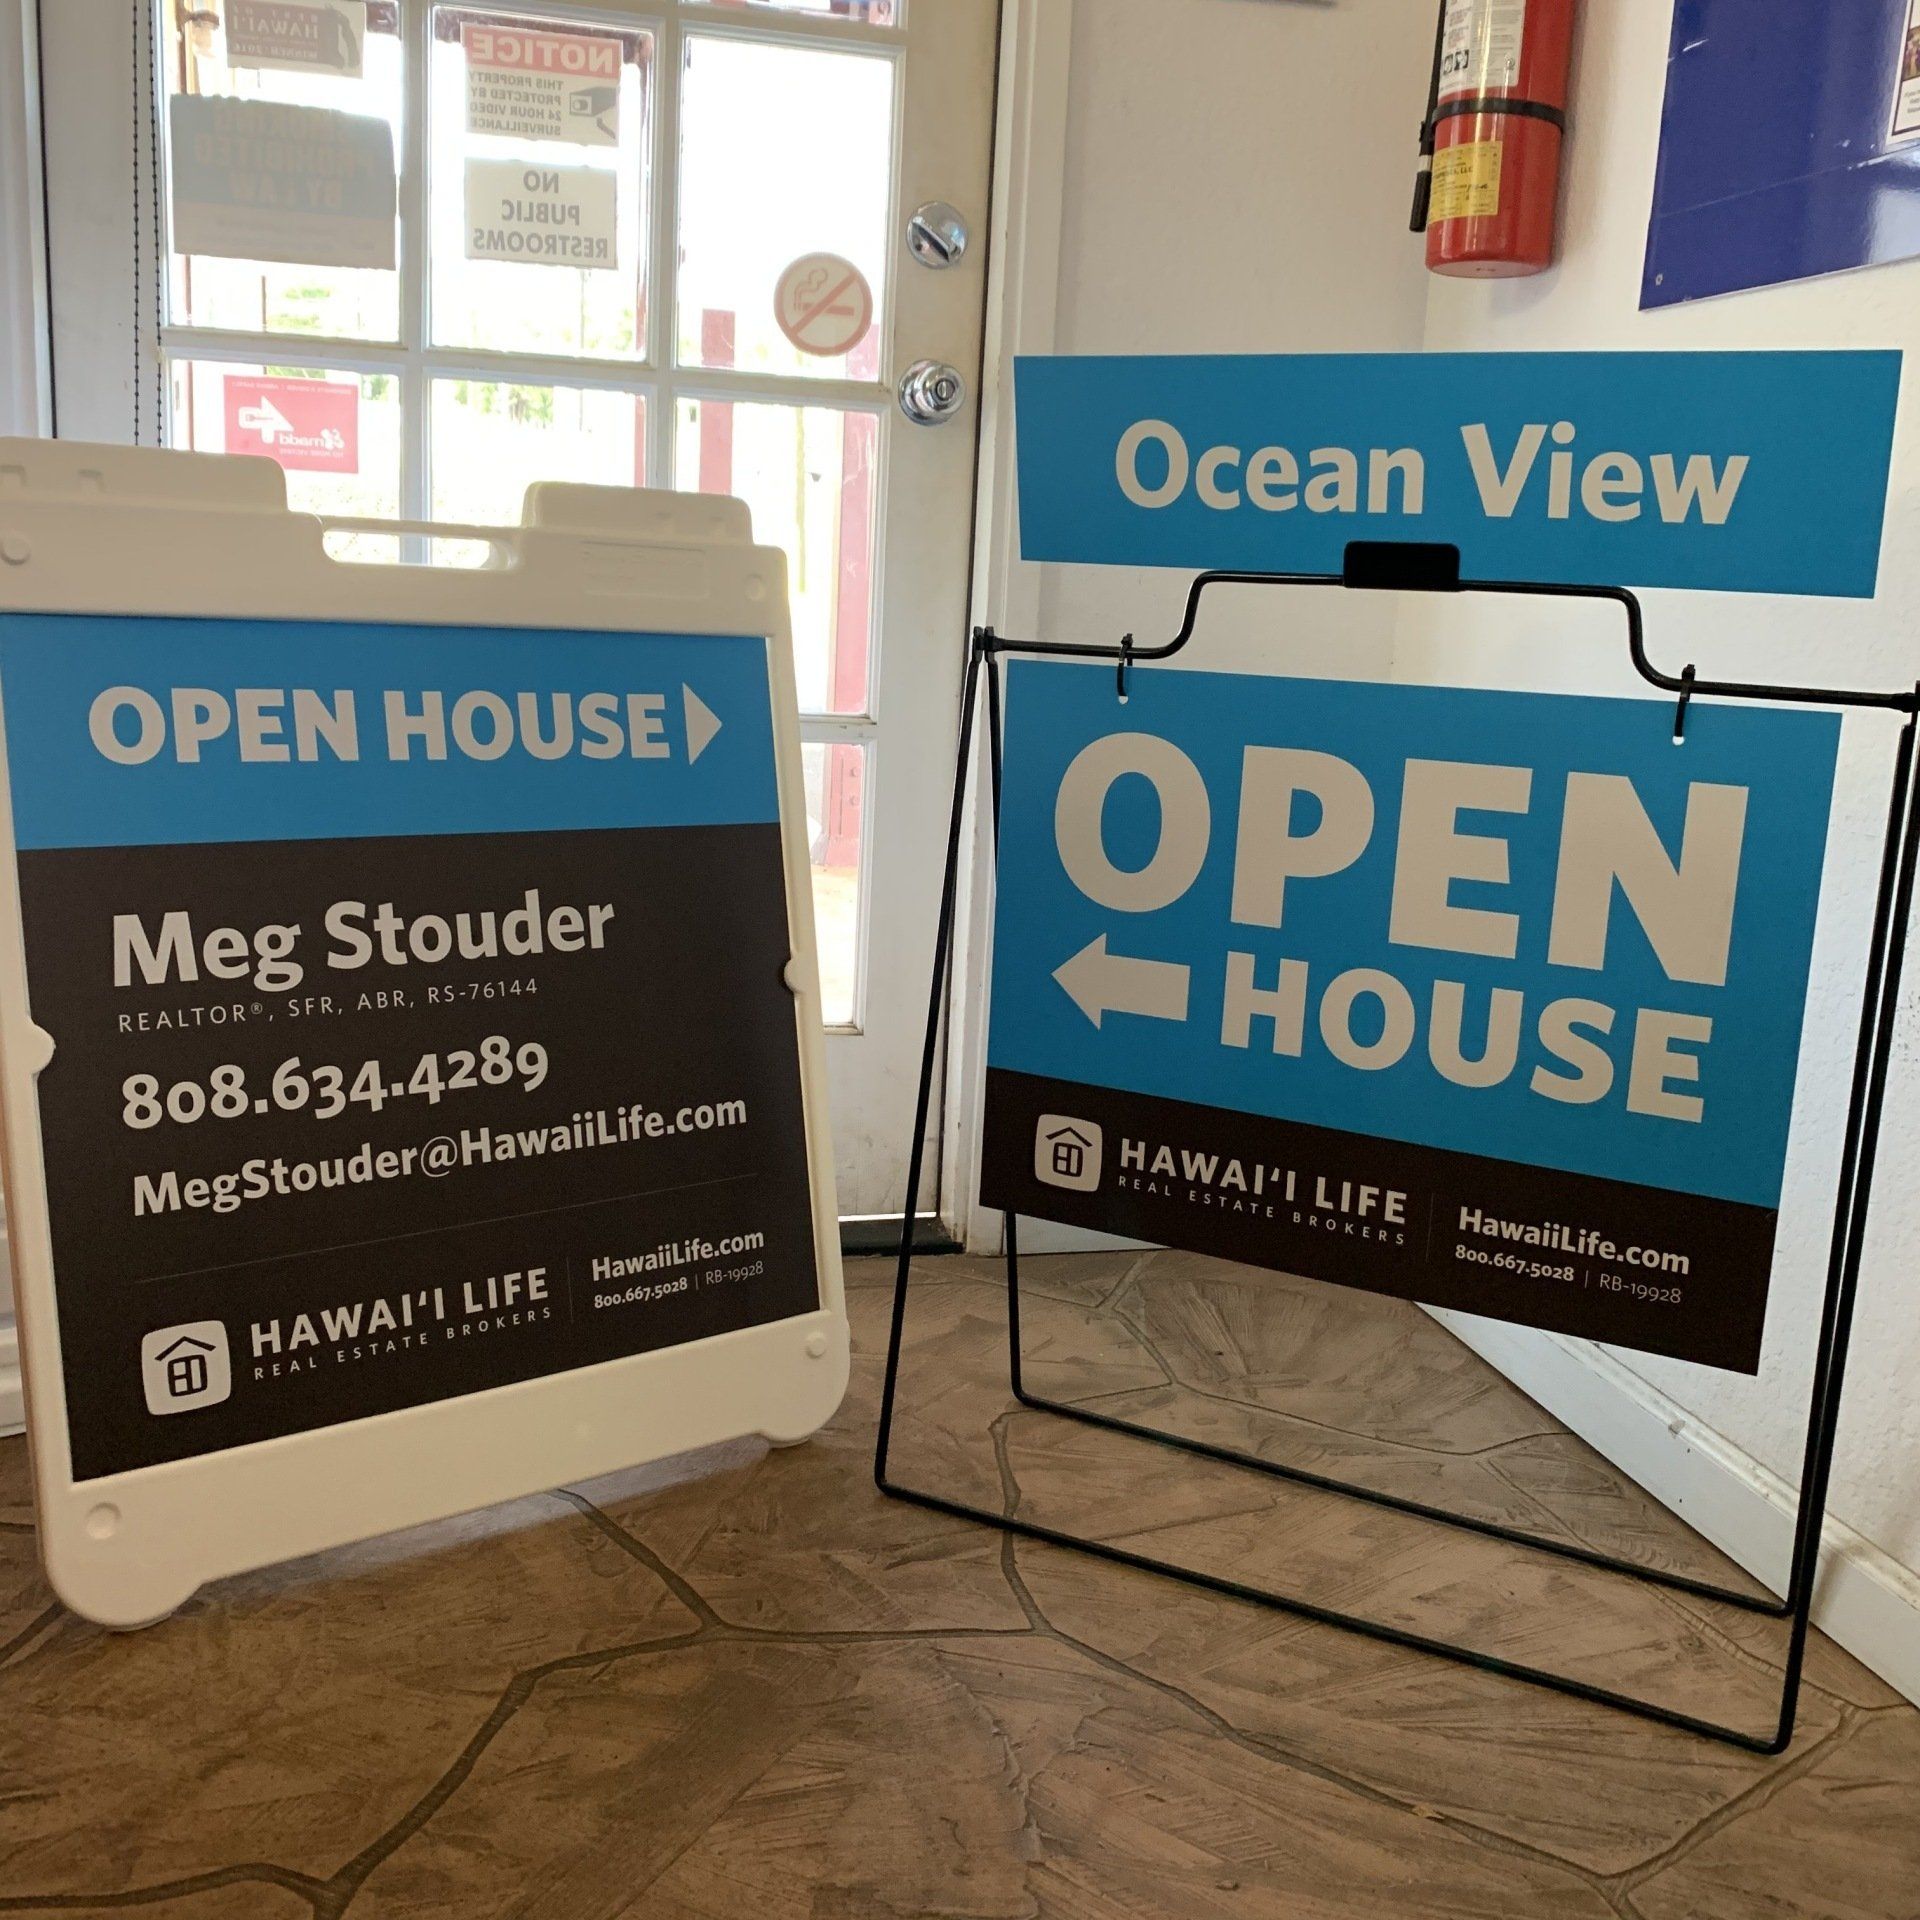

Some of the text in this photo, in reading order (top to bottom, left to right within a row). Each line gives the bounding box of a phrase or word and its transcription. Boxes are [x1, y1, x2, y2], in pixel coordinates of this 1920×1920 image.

[1115, 419, 1750, 526] Ocean View
[88, 686, 671, 765] OPEN HOUSE
[1054, 732, 1750, 987] OPEN
[113, 888, 615, 992] Meg Stouder
[288, 995, 343, 1017] SFR,
[358, 989, 414, 1011] ABR,
[428, 977, 538, 1004] RS-76144
[1220, 951, 1713, 1123] HOUSE
[121, 1035, 549, 1130] 808.634.4289
[134, 1098, 747, 1216] MegStouder@HawaiiLife.com
[1119, 1176, 1404, 1245] REAL ESTATE BROKERS
[1315, 1176, 1407, 1225] LIFE
[592, 1231, 765, 1282] HawaiiLife.com
[1455, 1244, 1682, 1303] 800.667.5028 RB-19928
[1459, 1206, 1690, 1275] HawaiiLife.com
[463, 1267, 549, 1314] LIFE
[594, 1260, 764, 1309] 800.667.5028 RB-19928
[254, 1307, 550, 1380] REAL ESTATE BROKERS
